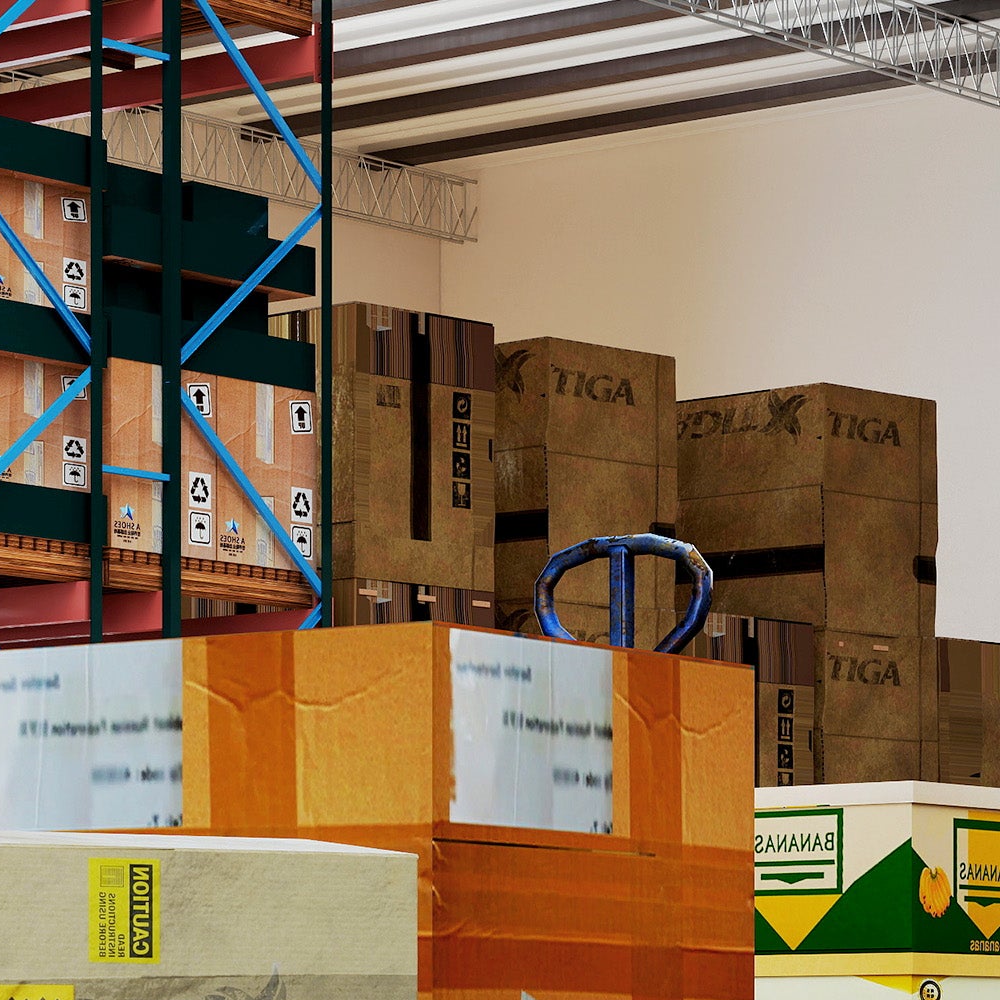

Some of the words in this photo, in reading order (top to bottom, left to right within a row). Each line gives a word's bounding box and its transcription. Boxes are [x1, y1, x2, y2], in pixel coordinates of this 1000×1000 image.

[550, 363, 636, 407] TIGA
[827, 407, 901, 448] TIGA
[827, 651, 901, 686] TIGA
